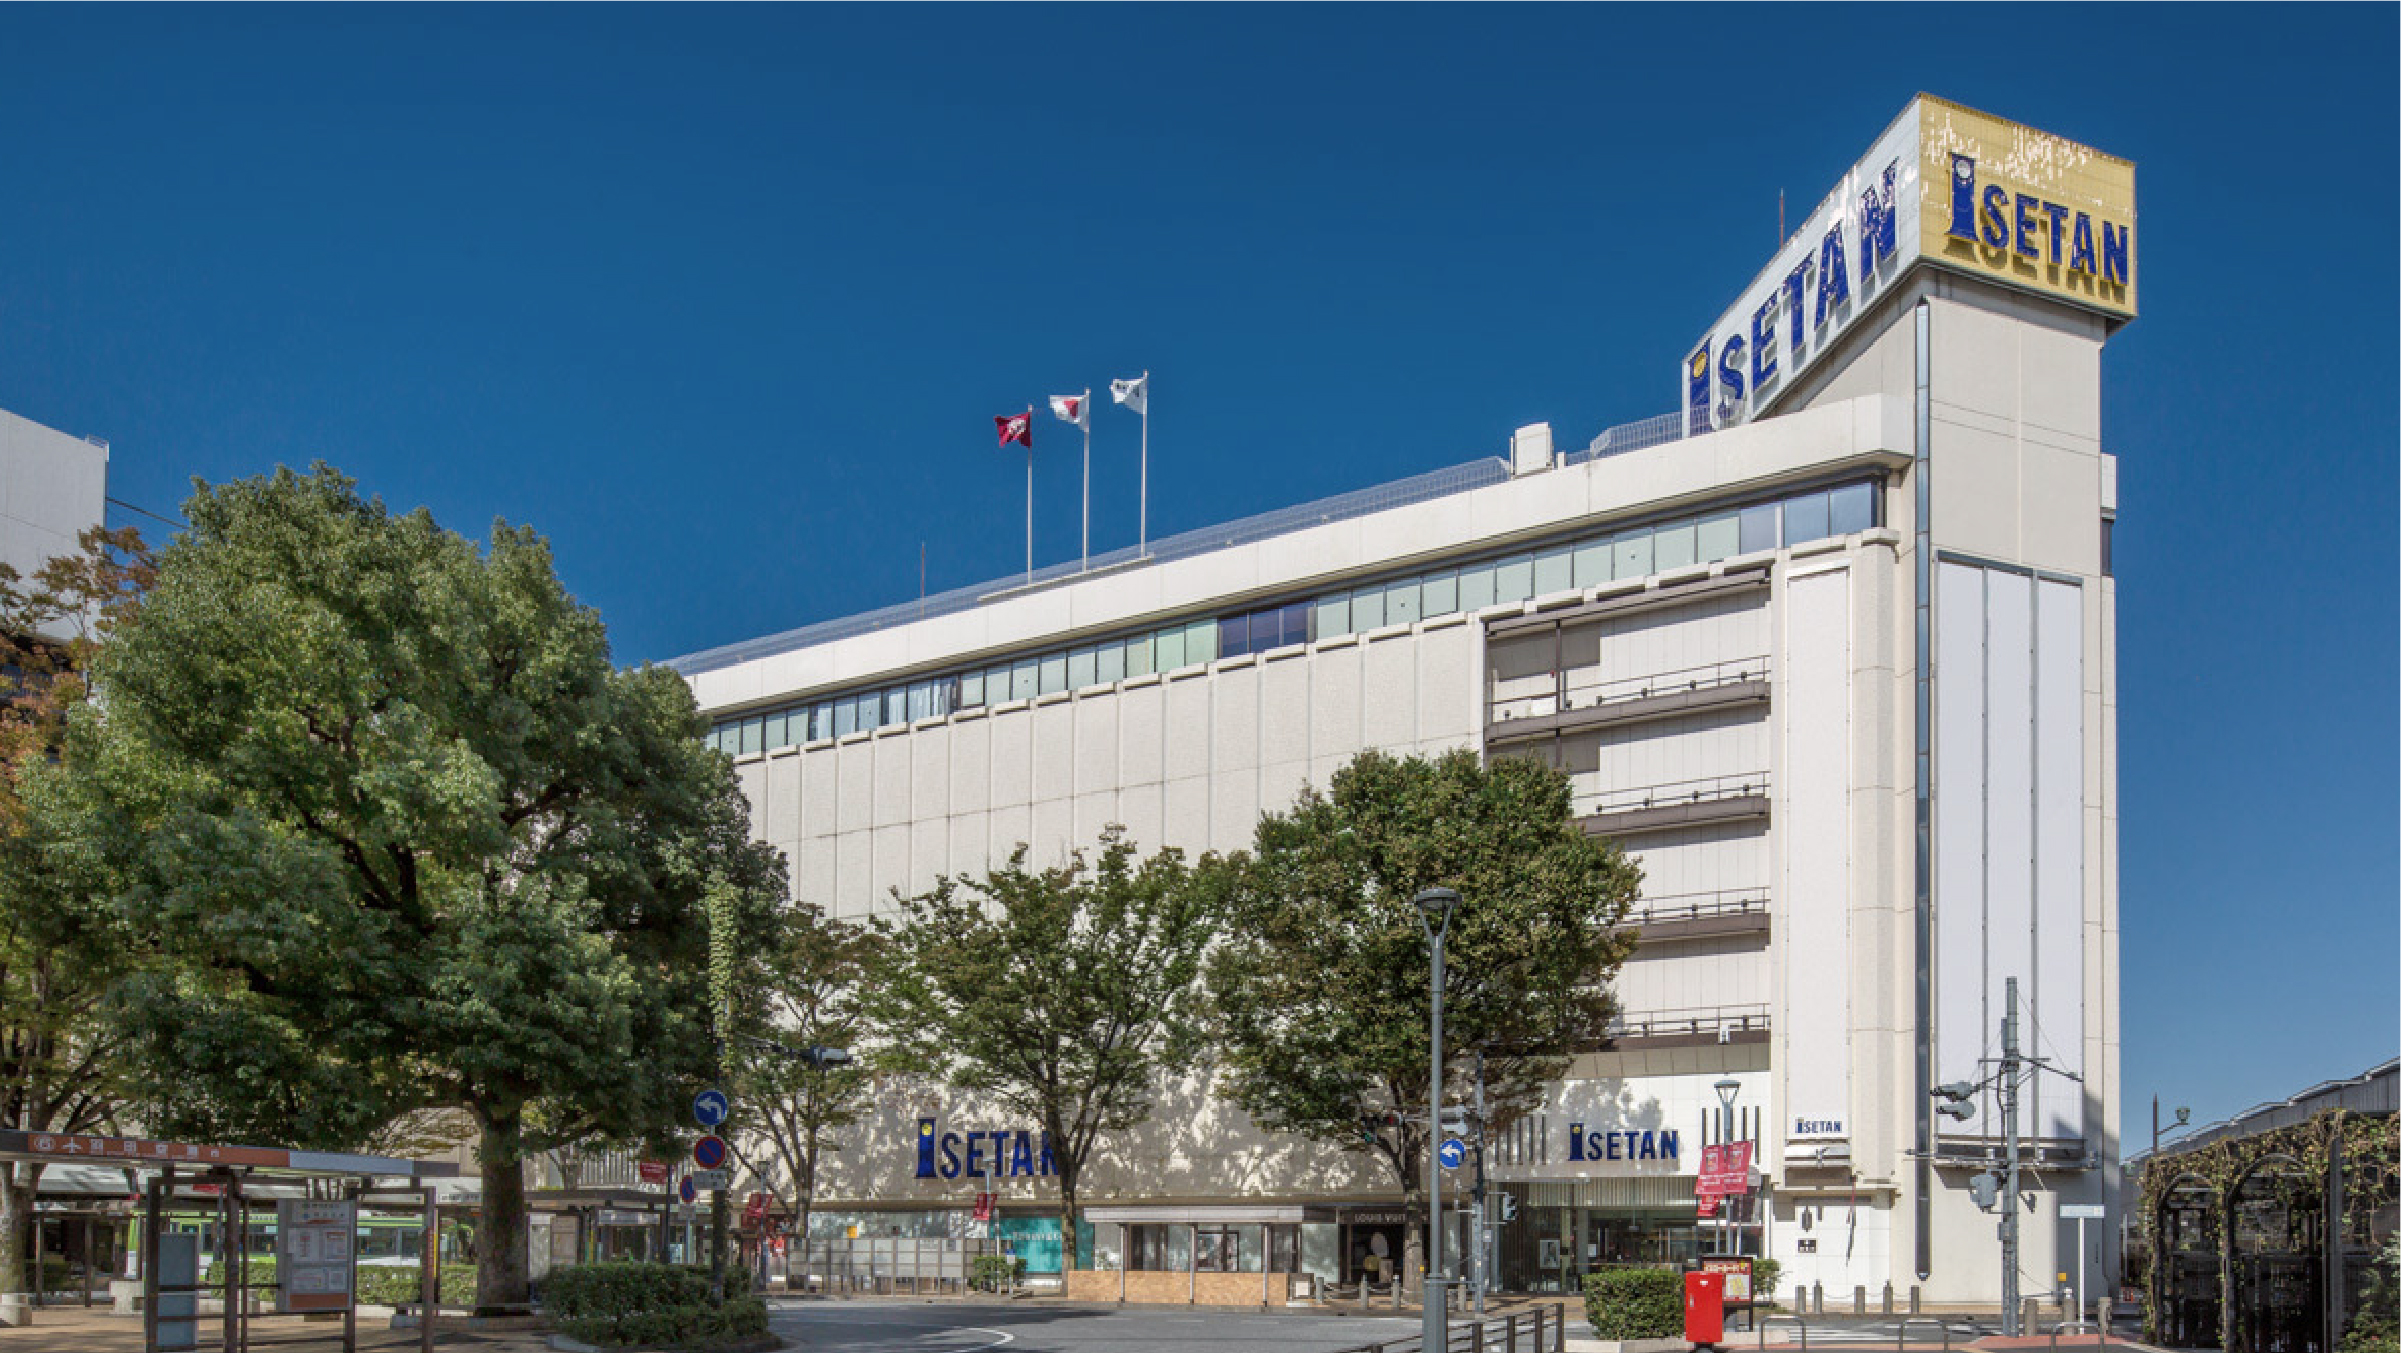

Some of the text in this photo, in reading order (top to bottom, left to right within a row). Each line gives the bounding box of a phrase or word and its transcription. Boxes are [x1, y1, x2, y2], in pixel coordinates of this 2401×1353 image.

[1945, 152, 2129, 286] ISETAN
[1689, 156, 1898, 436] ISETAN
[1568, 1123, 1679, 1161] ISETAN
[1795, 1117, 1842, 1133] ISETAN
